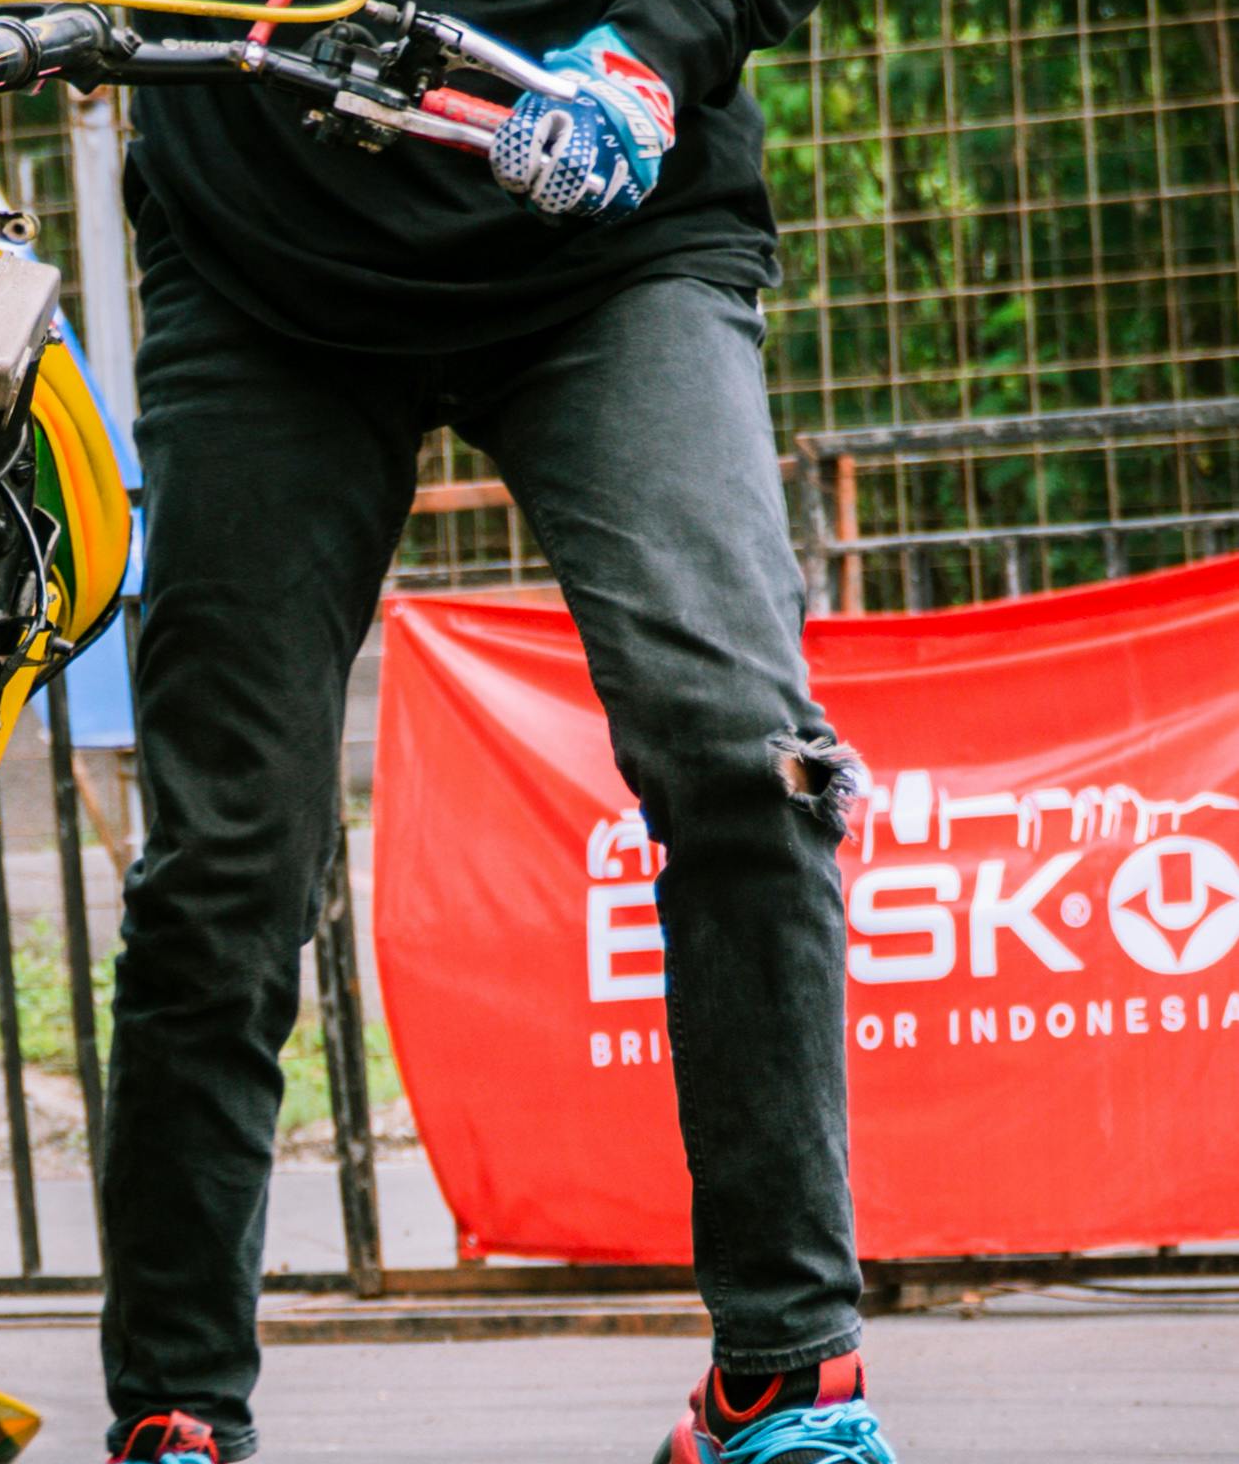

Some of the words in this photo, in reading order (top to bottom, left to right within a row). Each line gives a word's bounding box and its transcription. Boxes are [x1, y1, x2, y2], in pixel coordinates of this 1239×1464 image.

[589, 1028, 672, 1068] BRI
[855, 1011, 919, 1051] OR
[948, 992, 1239, 1046] INDONESIA
